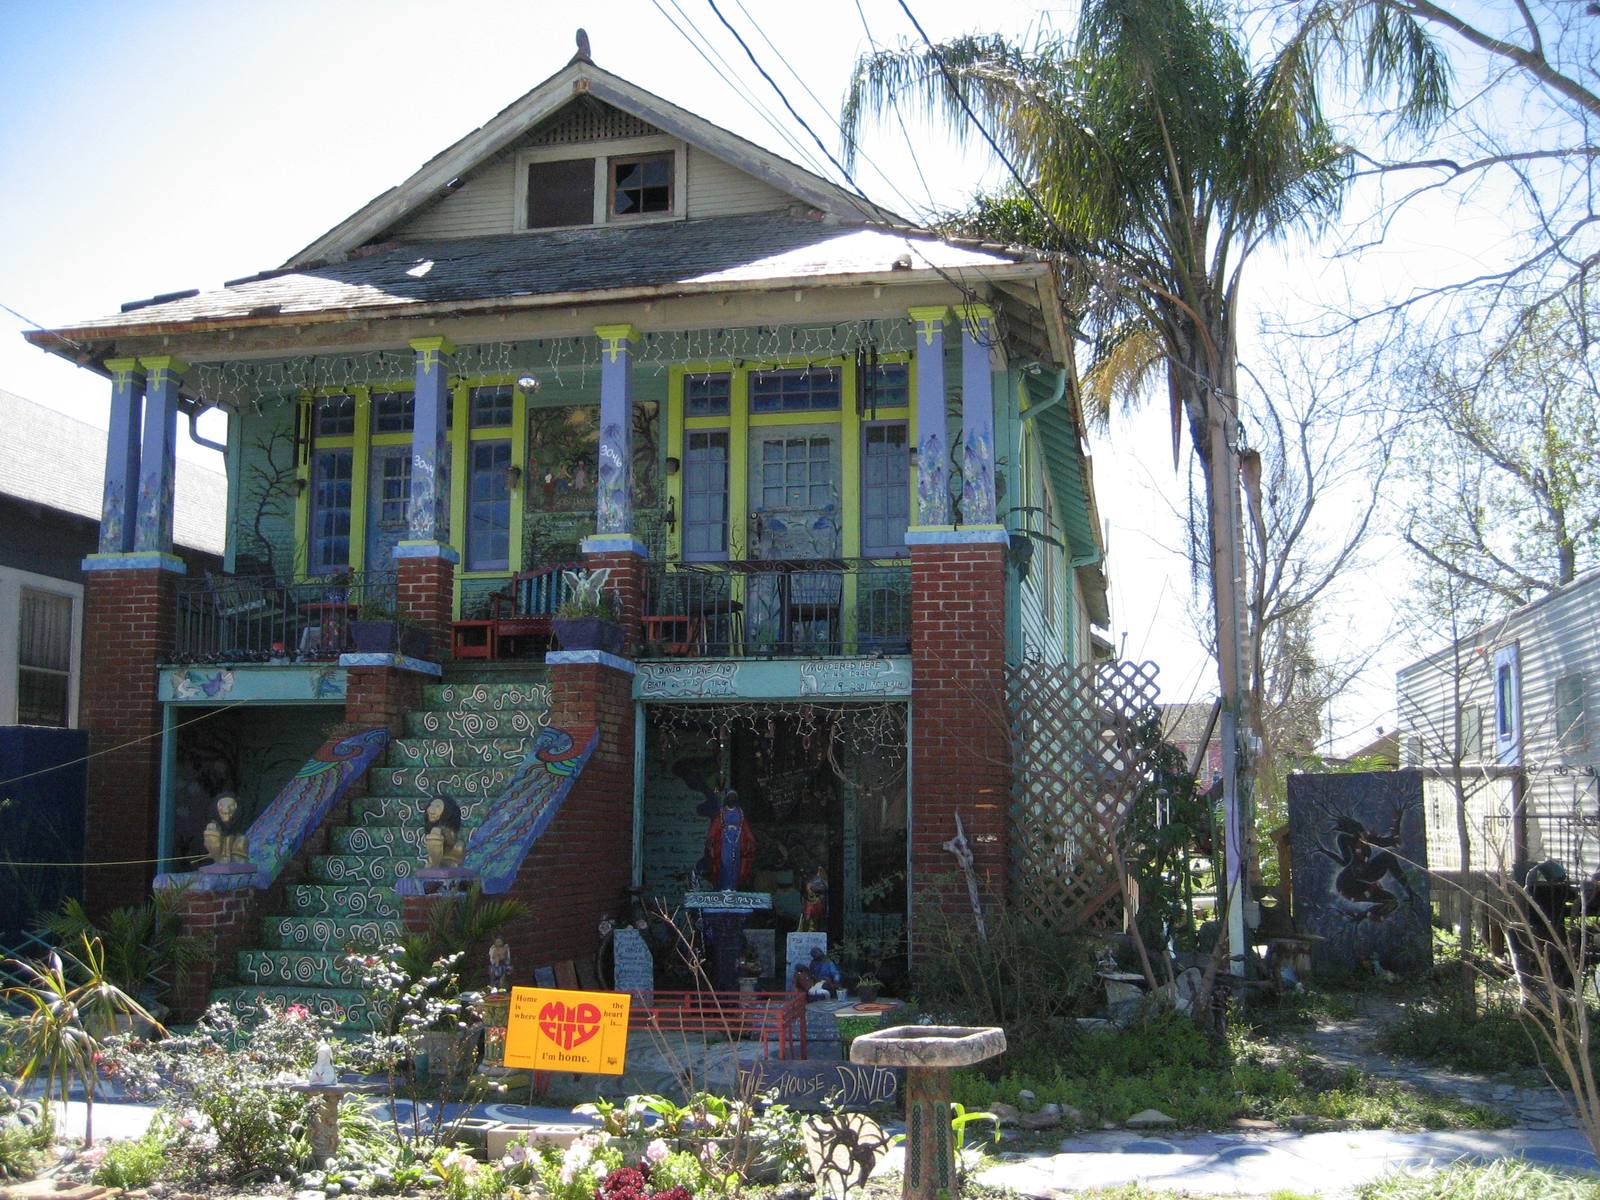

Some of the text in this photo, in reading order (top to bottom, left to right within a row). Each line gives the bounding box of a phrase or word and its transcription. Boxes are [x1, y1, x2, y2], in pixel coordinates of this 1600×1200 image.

[414, 454, 435, 478] 3044
[599, 444, 623, 468] 3046
[516, 994, 538, 1003] Home
[514, 1012, 537, 1020] where
[538, 1001, 602, 1024] MID
[603, 1010, 623, 1018] heart
[539, 1022, 601, 1051] CITY
[541, 1052, 556, 1061] I'm
[558, 1052, 590, 1063] home.
[778, 1071, 825, 1098] HOUSE
[836, 1065, 897, 1106] DAVID
